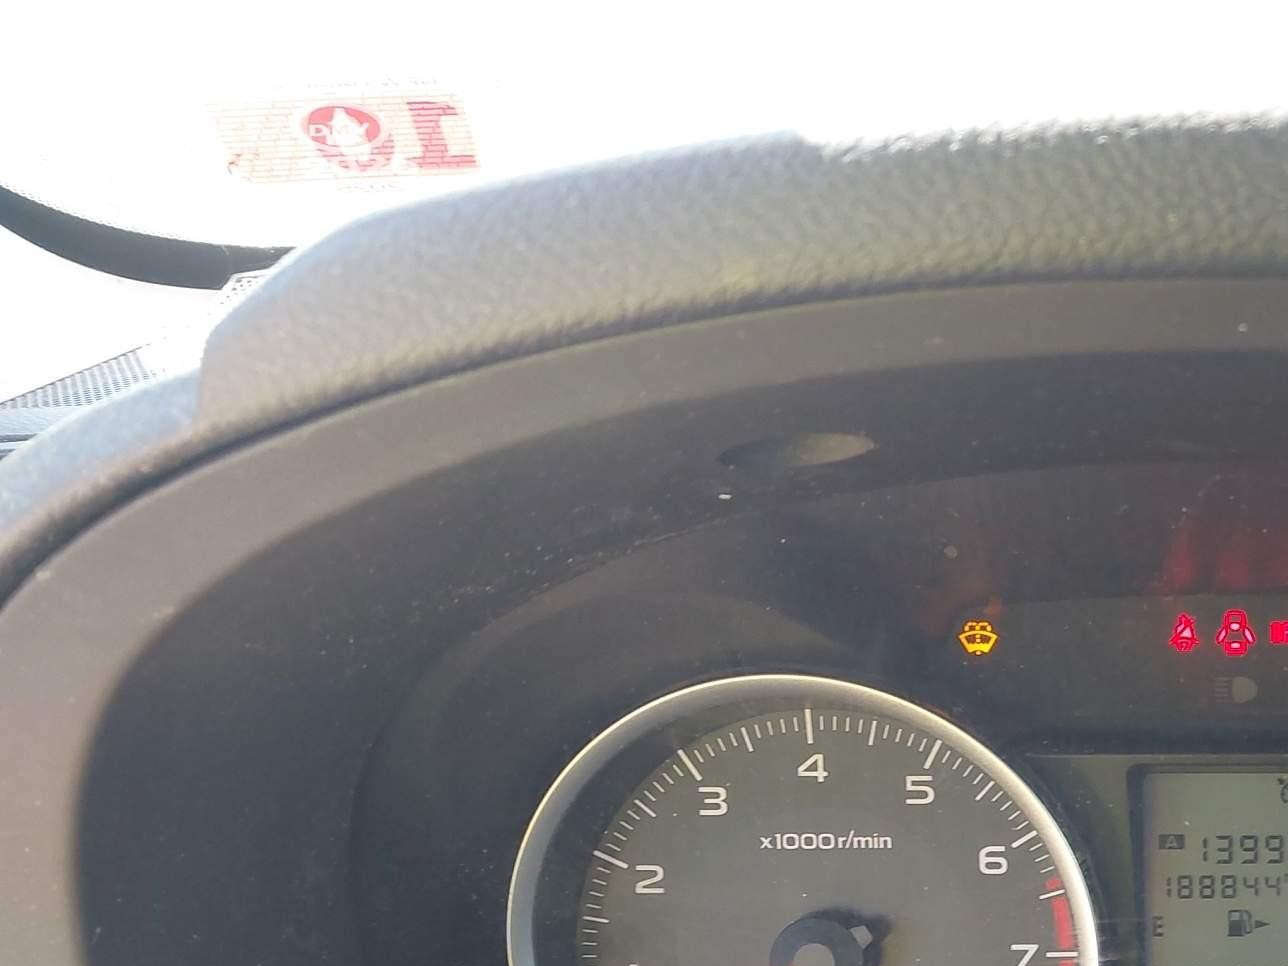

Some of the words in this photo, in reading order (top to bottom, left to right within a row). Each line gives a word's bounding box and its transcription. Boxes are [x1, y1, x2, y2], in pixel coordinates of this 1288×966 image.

[797, 754, 829, 783] 4
[698, 786, 728, 816] 3
[905, 775, 935, 805] 5
[978, 845, 1008, 875] 6
[1202, 835, 1284, 864] 1399
[635, 865, 664, 893] 2
[1166, 875, 1281, 899] 188844
[1152, 916, 1164, 937] E
